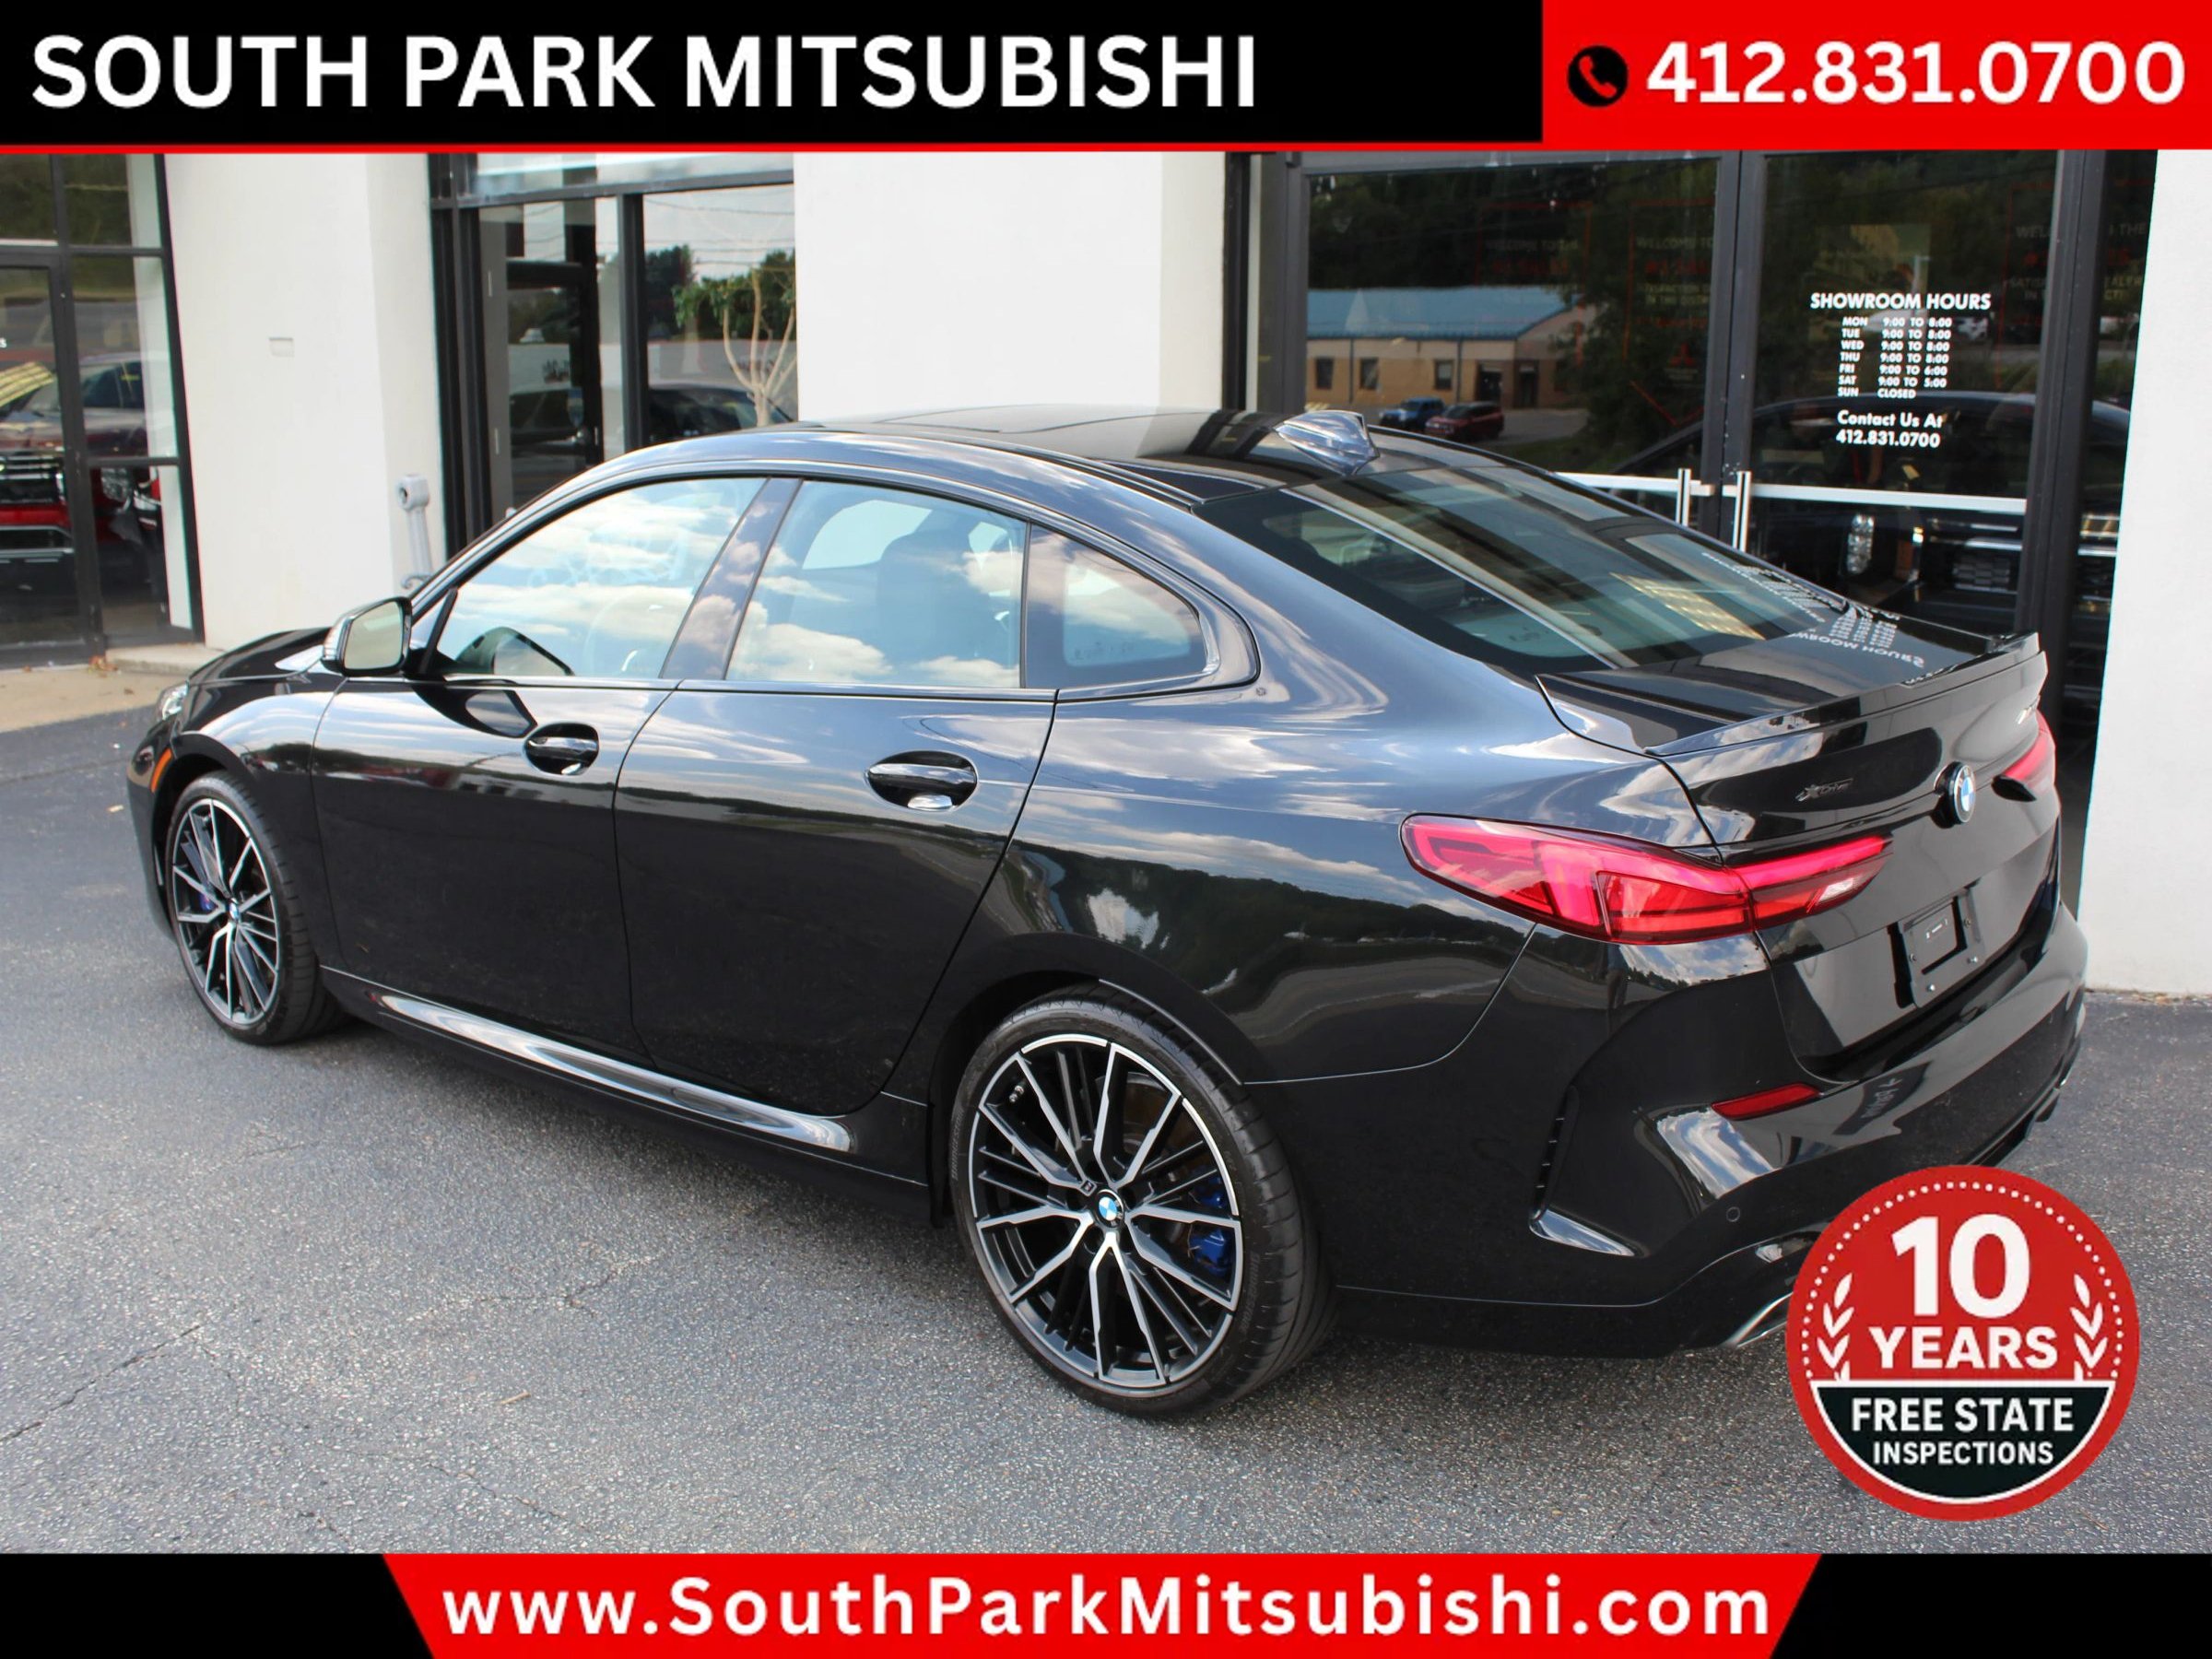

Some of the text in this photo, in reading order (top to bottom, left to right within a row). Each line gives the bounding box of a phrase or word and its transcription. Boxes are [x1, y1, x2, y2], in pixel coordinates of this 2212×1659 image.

[1810, 292, 1992, 310] SHOWROOM HOURS
[1842, 316, 1953, 328] MON 9:00 TO 8:00
[1841, 328, 1952, 340] TUE 9:00 TO 8:00
[1841, 340, 1950, 352] WED 9:00 TO 8:00
[1840, 351, 1949, 364] THU 9:00 TO 8:00
[1839, 363, 1947, 376] FRI 9:00 TO 6:00
[1838, 375, 1947, 388] SAT 9:00 TO 5:00
[1837, 387, 1917, 399] SUN CLOSED
[1837, 409, 1944, 429] Contact Us At
[1835, 428, 1941, 448] 412.831.0700
